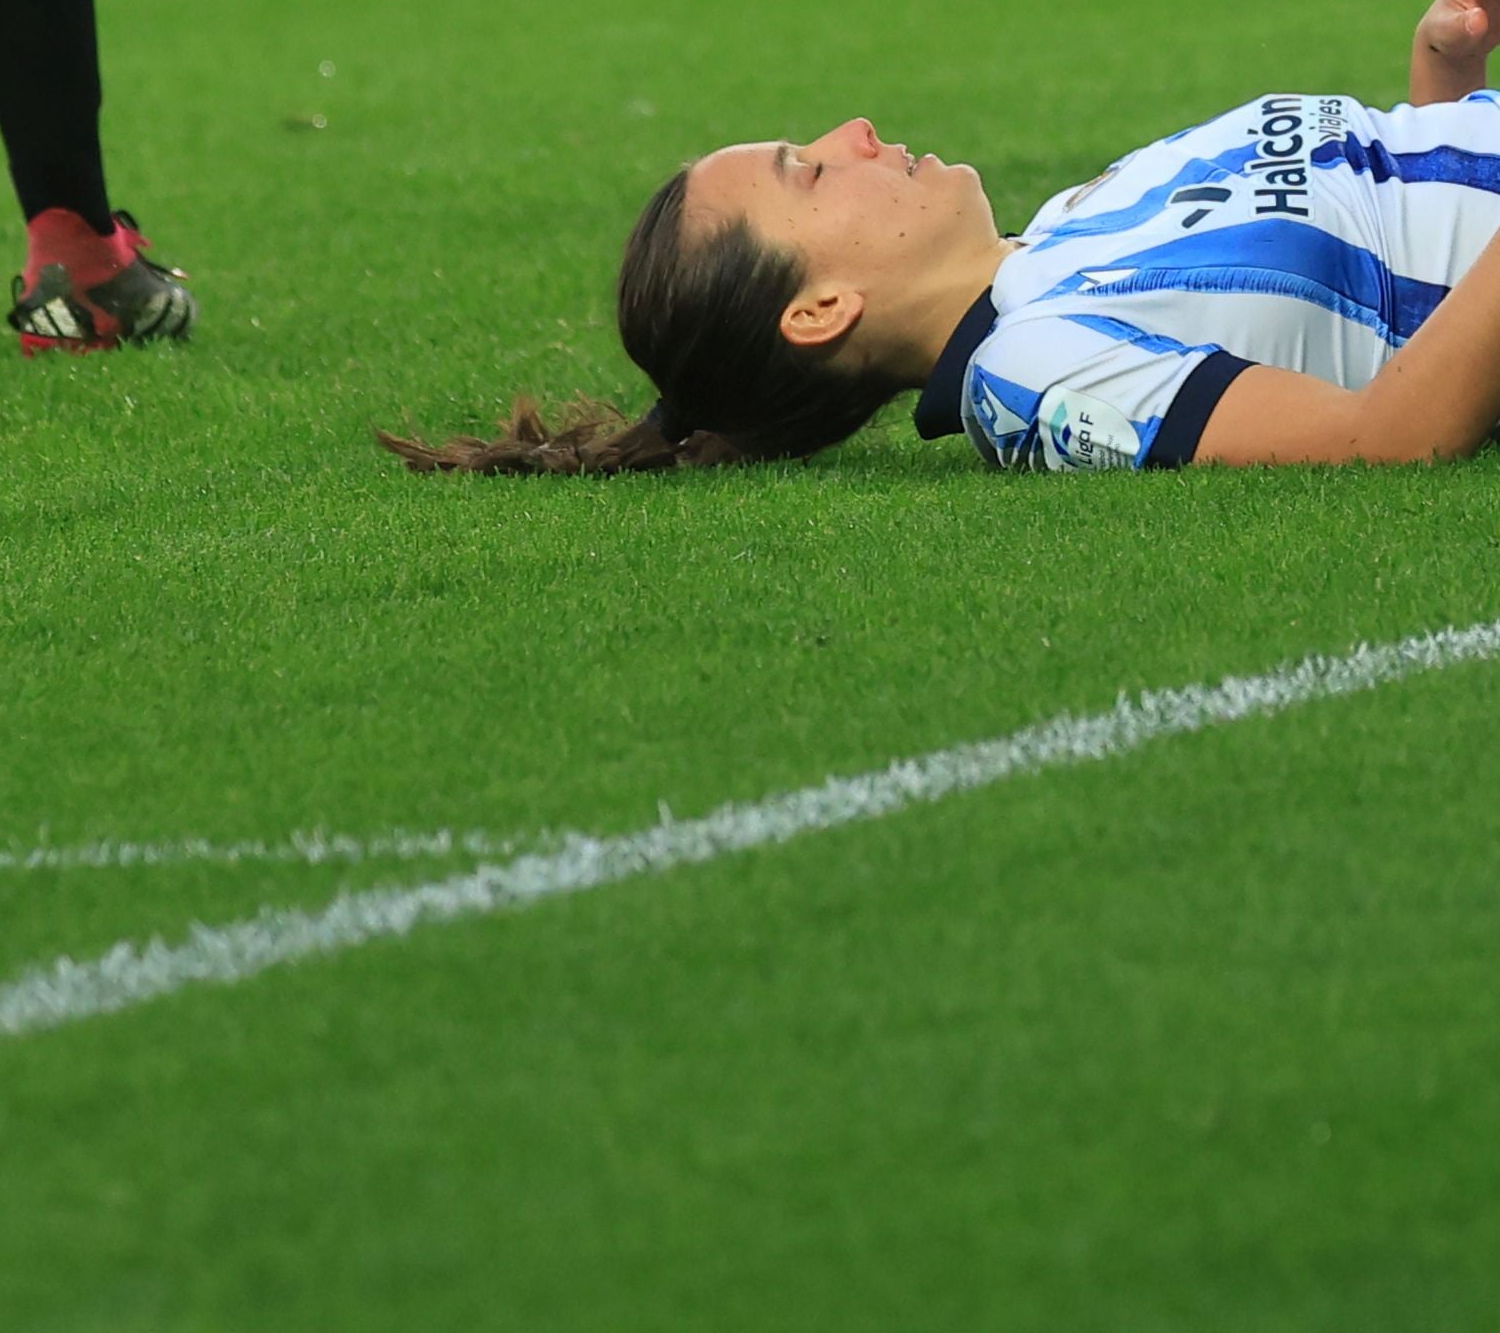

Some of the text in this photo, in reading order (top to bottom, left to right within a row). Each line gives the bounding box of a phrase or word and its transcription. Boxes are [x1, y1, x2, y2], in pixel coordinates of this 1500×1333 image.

[1308, 98, 1348, 143] viajes
[1246, 97, 1309, 218] Halcón
[1075, 411, 1095, 466] Liga F
